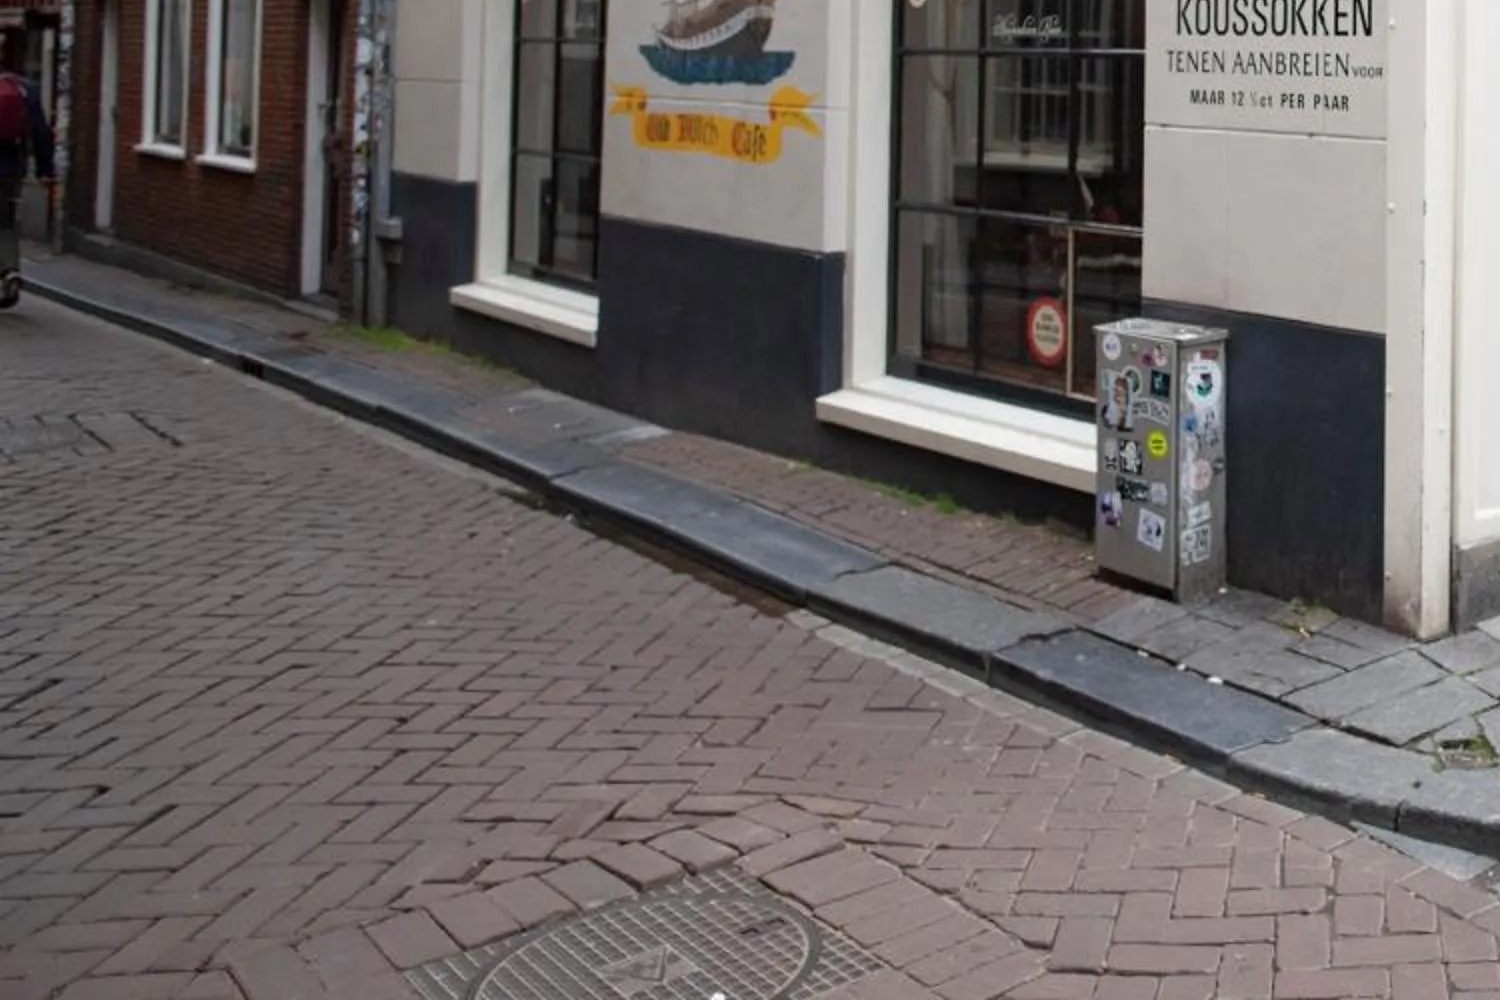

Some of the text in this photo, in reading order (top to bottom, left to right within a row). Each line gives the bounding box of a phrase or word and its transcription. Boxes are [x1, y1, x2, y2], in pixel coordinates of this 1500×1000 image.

[1167, 50, 1383, 79] TENEN AANBREIEN VOOR
[1189, 88, 1226, 107] MAAR
[1279, 93, 1306, 110] PER
[1313, 93, 1350, 113] PAAR
